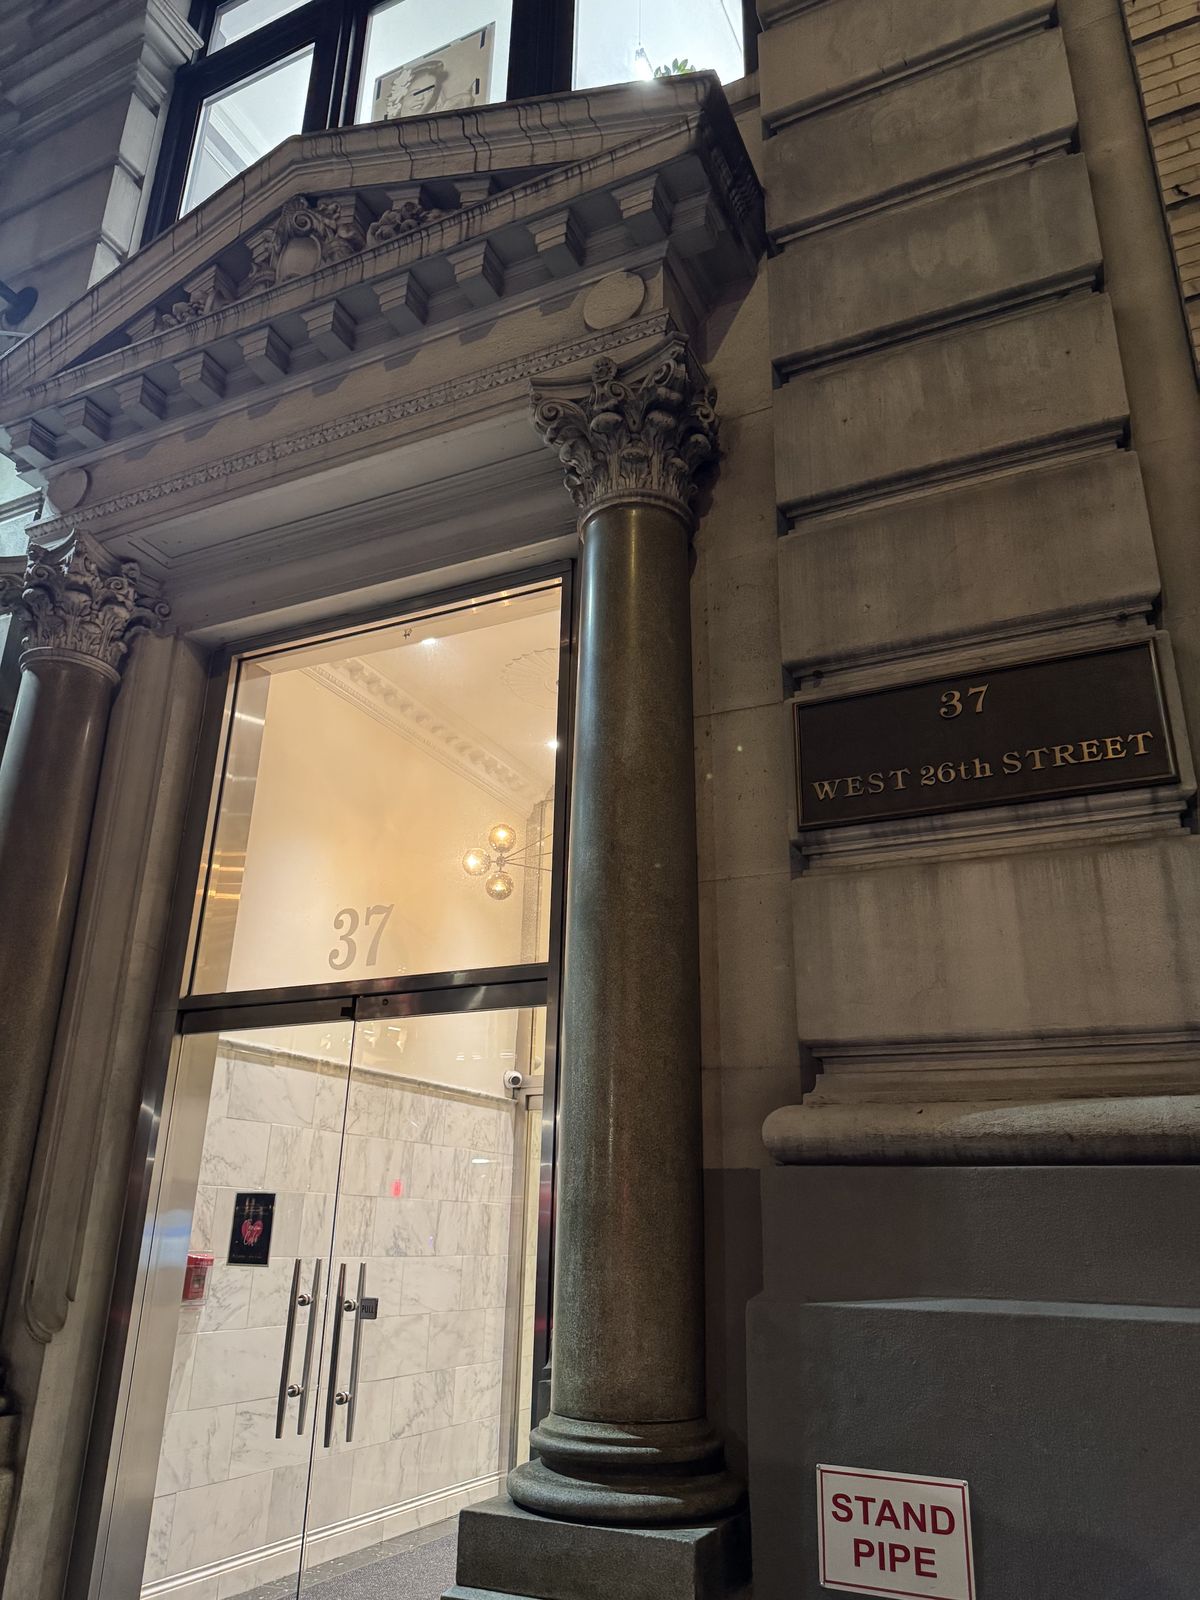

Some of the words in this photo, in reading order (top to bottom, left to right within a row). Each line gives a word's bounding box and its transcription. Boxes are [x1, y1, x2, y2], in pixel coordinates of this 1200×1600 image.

[939, 683, 989, 718] 37
[811, 768, 911, 800] WEST
[920, 758, 994, 787] 26th
[1003, 731, 1153, 775] STREET
[328, 903, 395, 970] 37
[831, 1493, 955, 1536] STAND
[853, 1538, 938, 1579] PIPE
